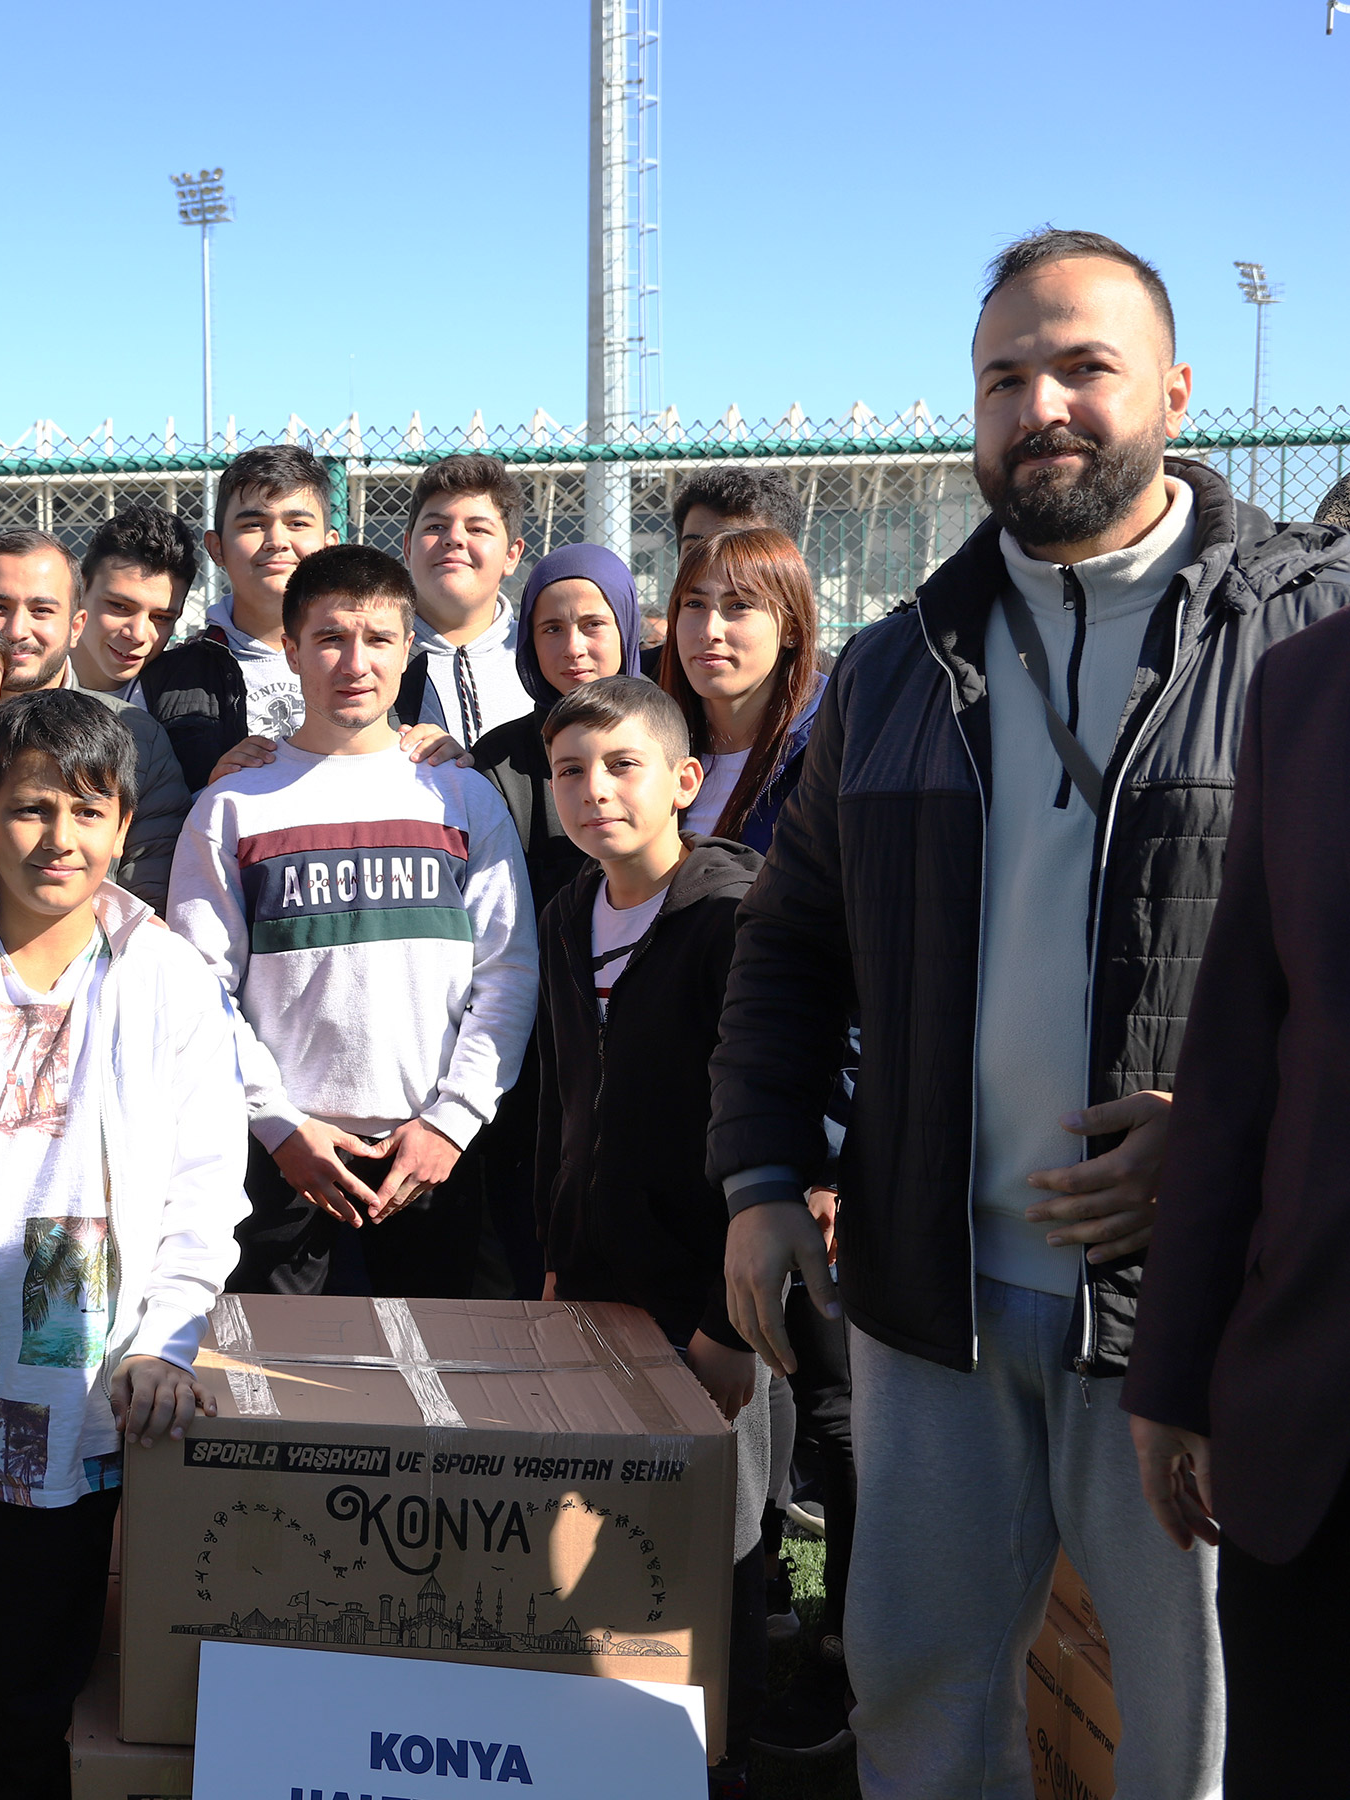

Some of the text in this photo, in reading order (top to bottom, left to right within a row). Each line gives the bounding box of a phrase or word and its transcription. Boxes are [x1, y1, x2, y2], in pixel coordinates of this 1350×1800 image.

[248, 682, 302, 702] UNIVE
[282, 857, 440, 908] AROUND
[307, 873, 415, 889] DOWNTOWN
[192, 1442, 278, 1466] SPORLA
[287, 1446, 387, 1471] YAŞAYAN
[395, 1451, 426, 1474] VE
[432, 1452, 506, 1476] SPORU
[513, 1456, 614, 1482] YAŞATAN
[326, 1484, 532, 1576] KONYA
[369, 1731, 534, 1785] KONYA
